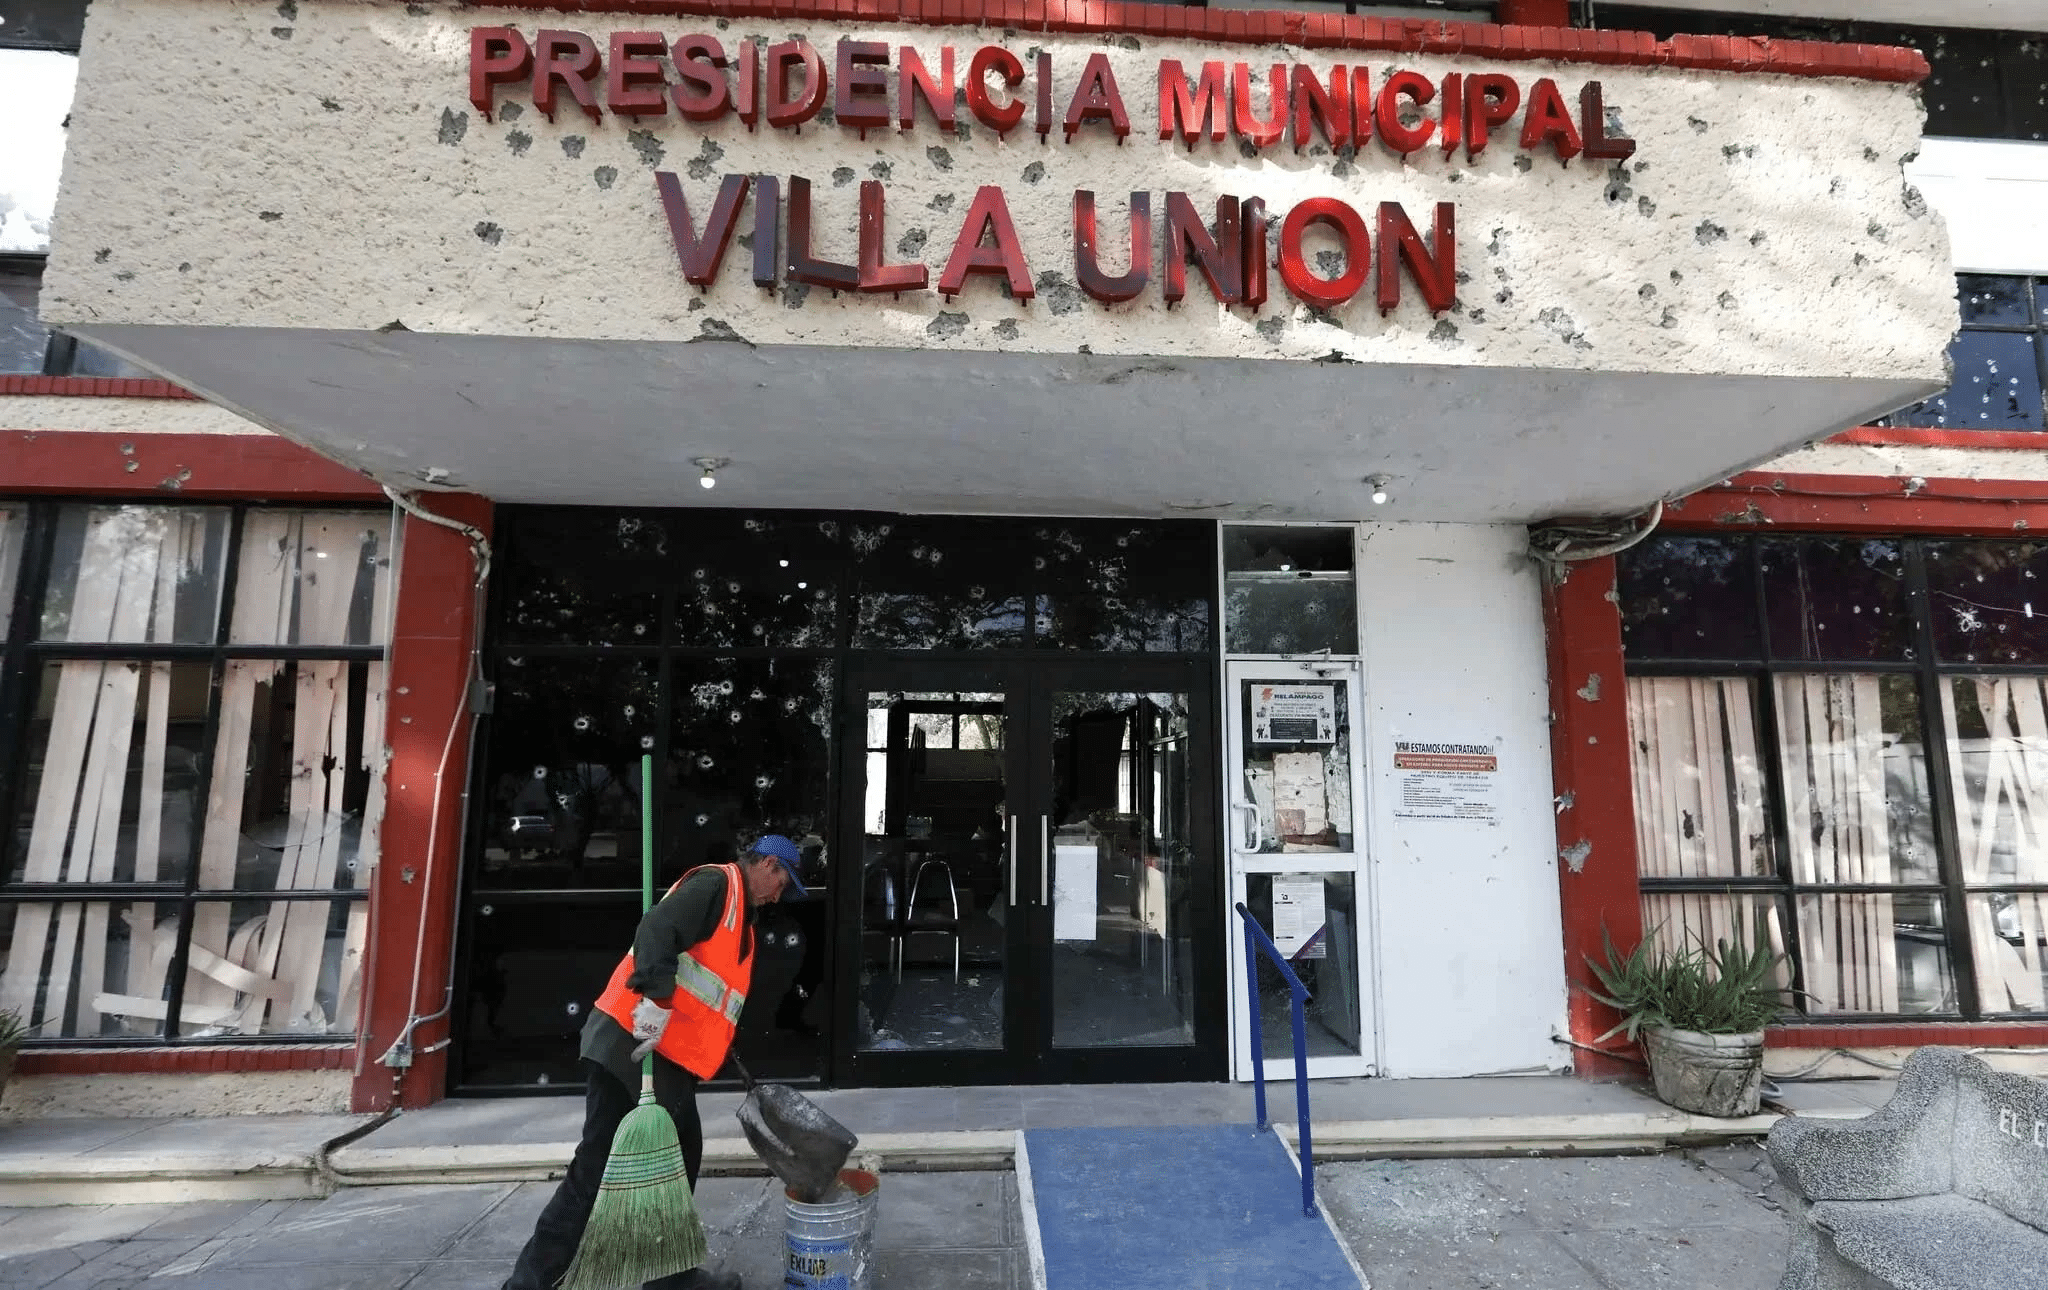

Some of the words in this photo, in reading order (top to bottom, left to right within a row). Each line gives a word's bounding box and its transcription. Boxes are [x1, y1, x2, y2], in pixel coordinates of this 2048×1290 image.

[470, 26, 1130, 136] PRESIDENCIA
[1158, 58, 1637, 160] MUNICIPAL
[654, 170, 1035, 299] VILLA
[1072, 189, 1456, 312] UNION
[1411, 743, 1441, 753] ESTAMOS
[2000, 1108, 2022, 1139] EL
[2034, 1121, 2048, 1149] C
